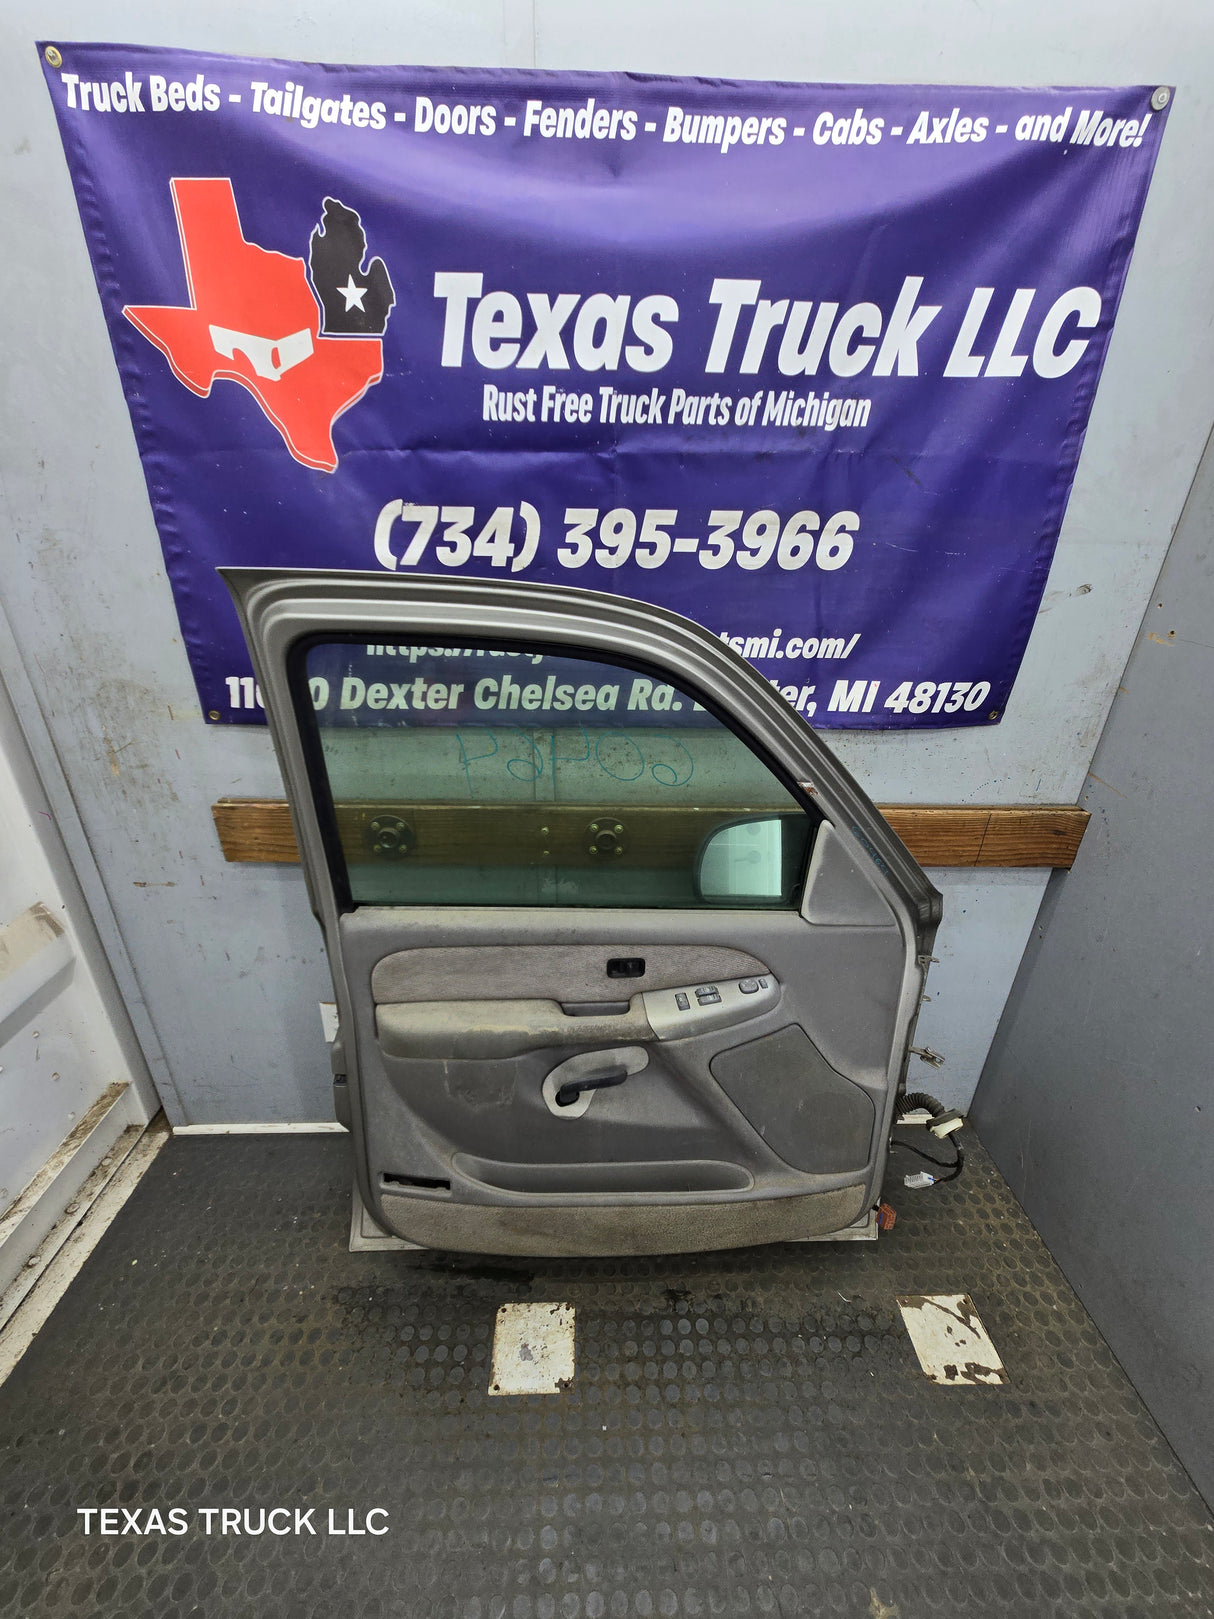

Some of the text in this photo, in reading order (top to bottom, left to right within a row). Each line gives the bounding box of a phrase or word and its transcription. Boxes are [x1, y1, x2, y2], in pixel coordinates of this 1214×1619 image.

[61, 72, 145, 113] Truck
[149, 74, 221, 112] Beds
[249, 81, 386, 131] Tailgates
[414, 96, 497, 136] Doors
[523, 98, 638, 141] Fenders
[663, 106, 787, 154] Bumpers
[812, 110, 883, 146] Cabs
[906, 108, 988, 145] Axles
[1015, 106, 1073, 142] and
[1068, 110, 1154, 148] More!
[434, 272, 1102, 379] Texas Truck LLC
[483, 384, 872, 432] Rust Free Truck Parts of Michigan
[374, 499, 860, 573] (734) 395-3966
[340, 676, 464, 710] Dexter
[474, 674, 620, 711] Chelsea
[827, 680, 880, 712] MI
[884, 681, 991, 714] 48130
